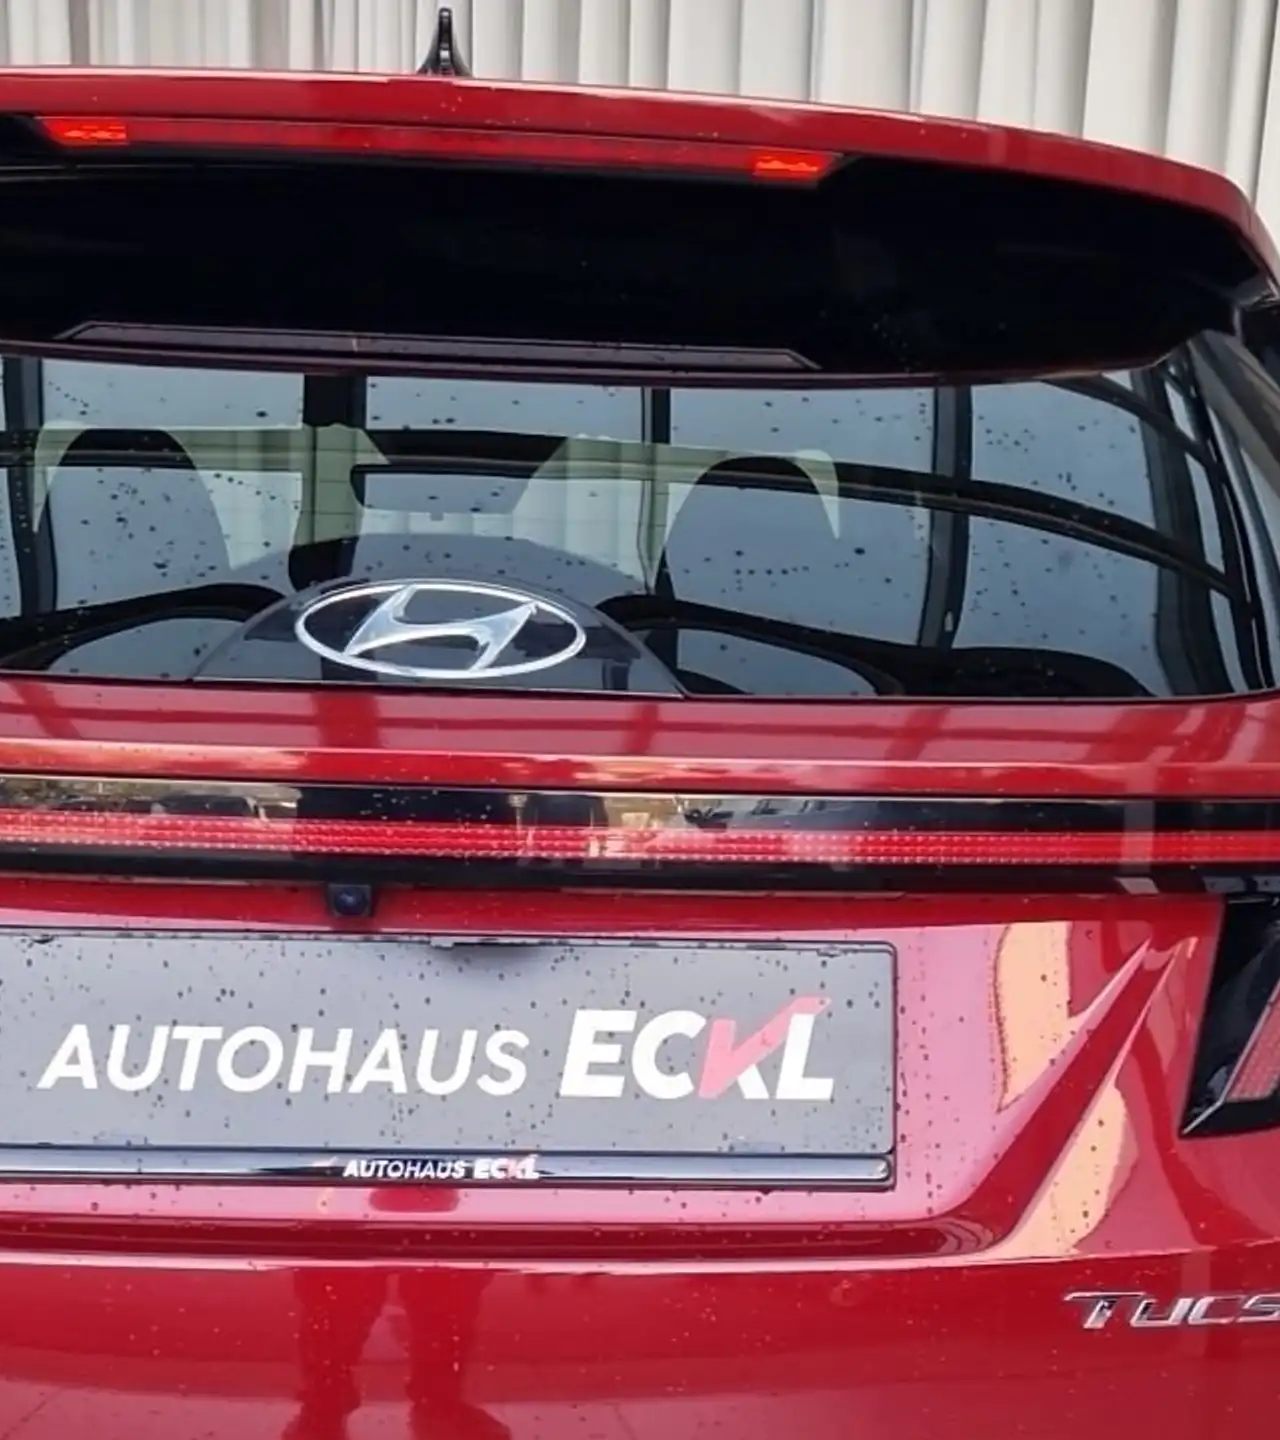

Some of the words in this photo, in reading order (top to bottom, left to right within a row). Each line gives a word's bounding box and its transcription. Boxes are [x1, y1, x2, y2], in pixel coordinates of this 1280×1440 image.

[37, 1023, 531, 1097] AUTOHAUS
[559, 996, 836, 1101] ECKL
[342, 1158, 468, 1180] AUTOHAUS
